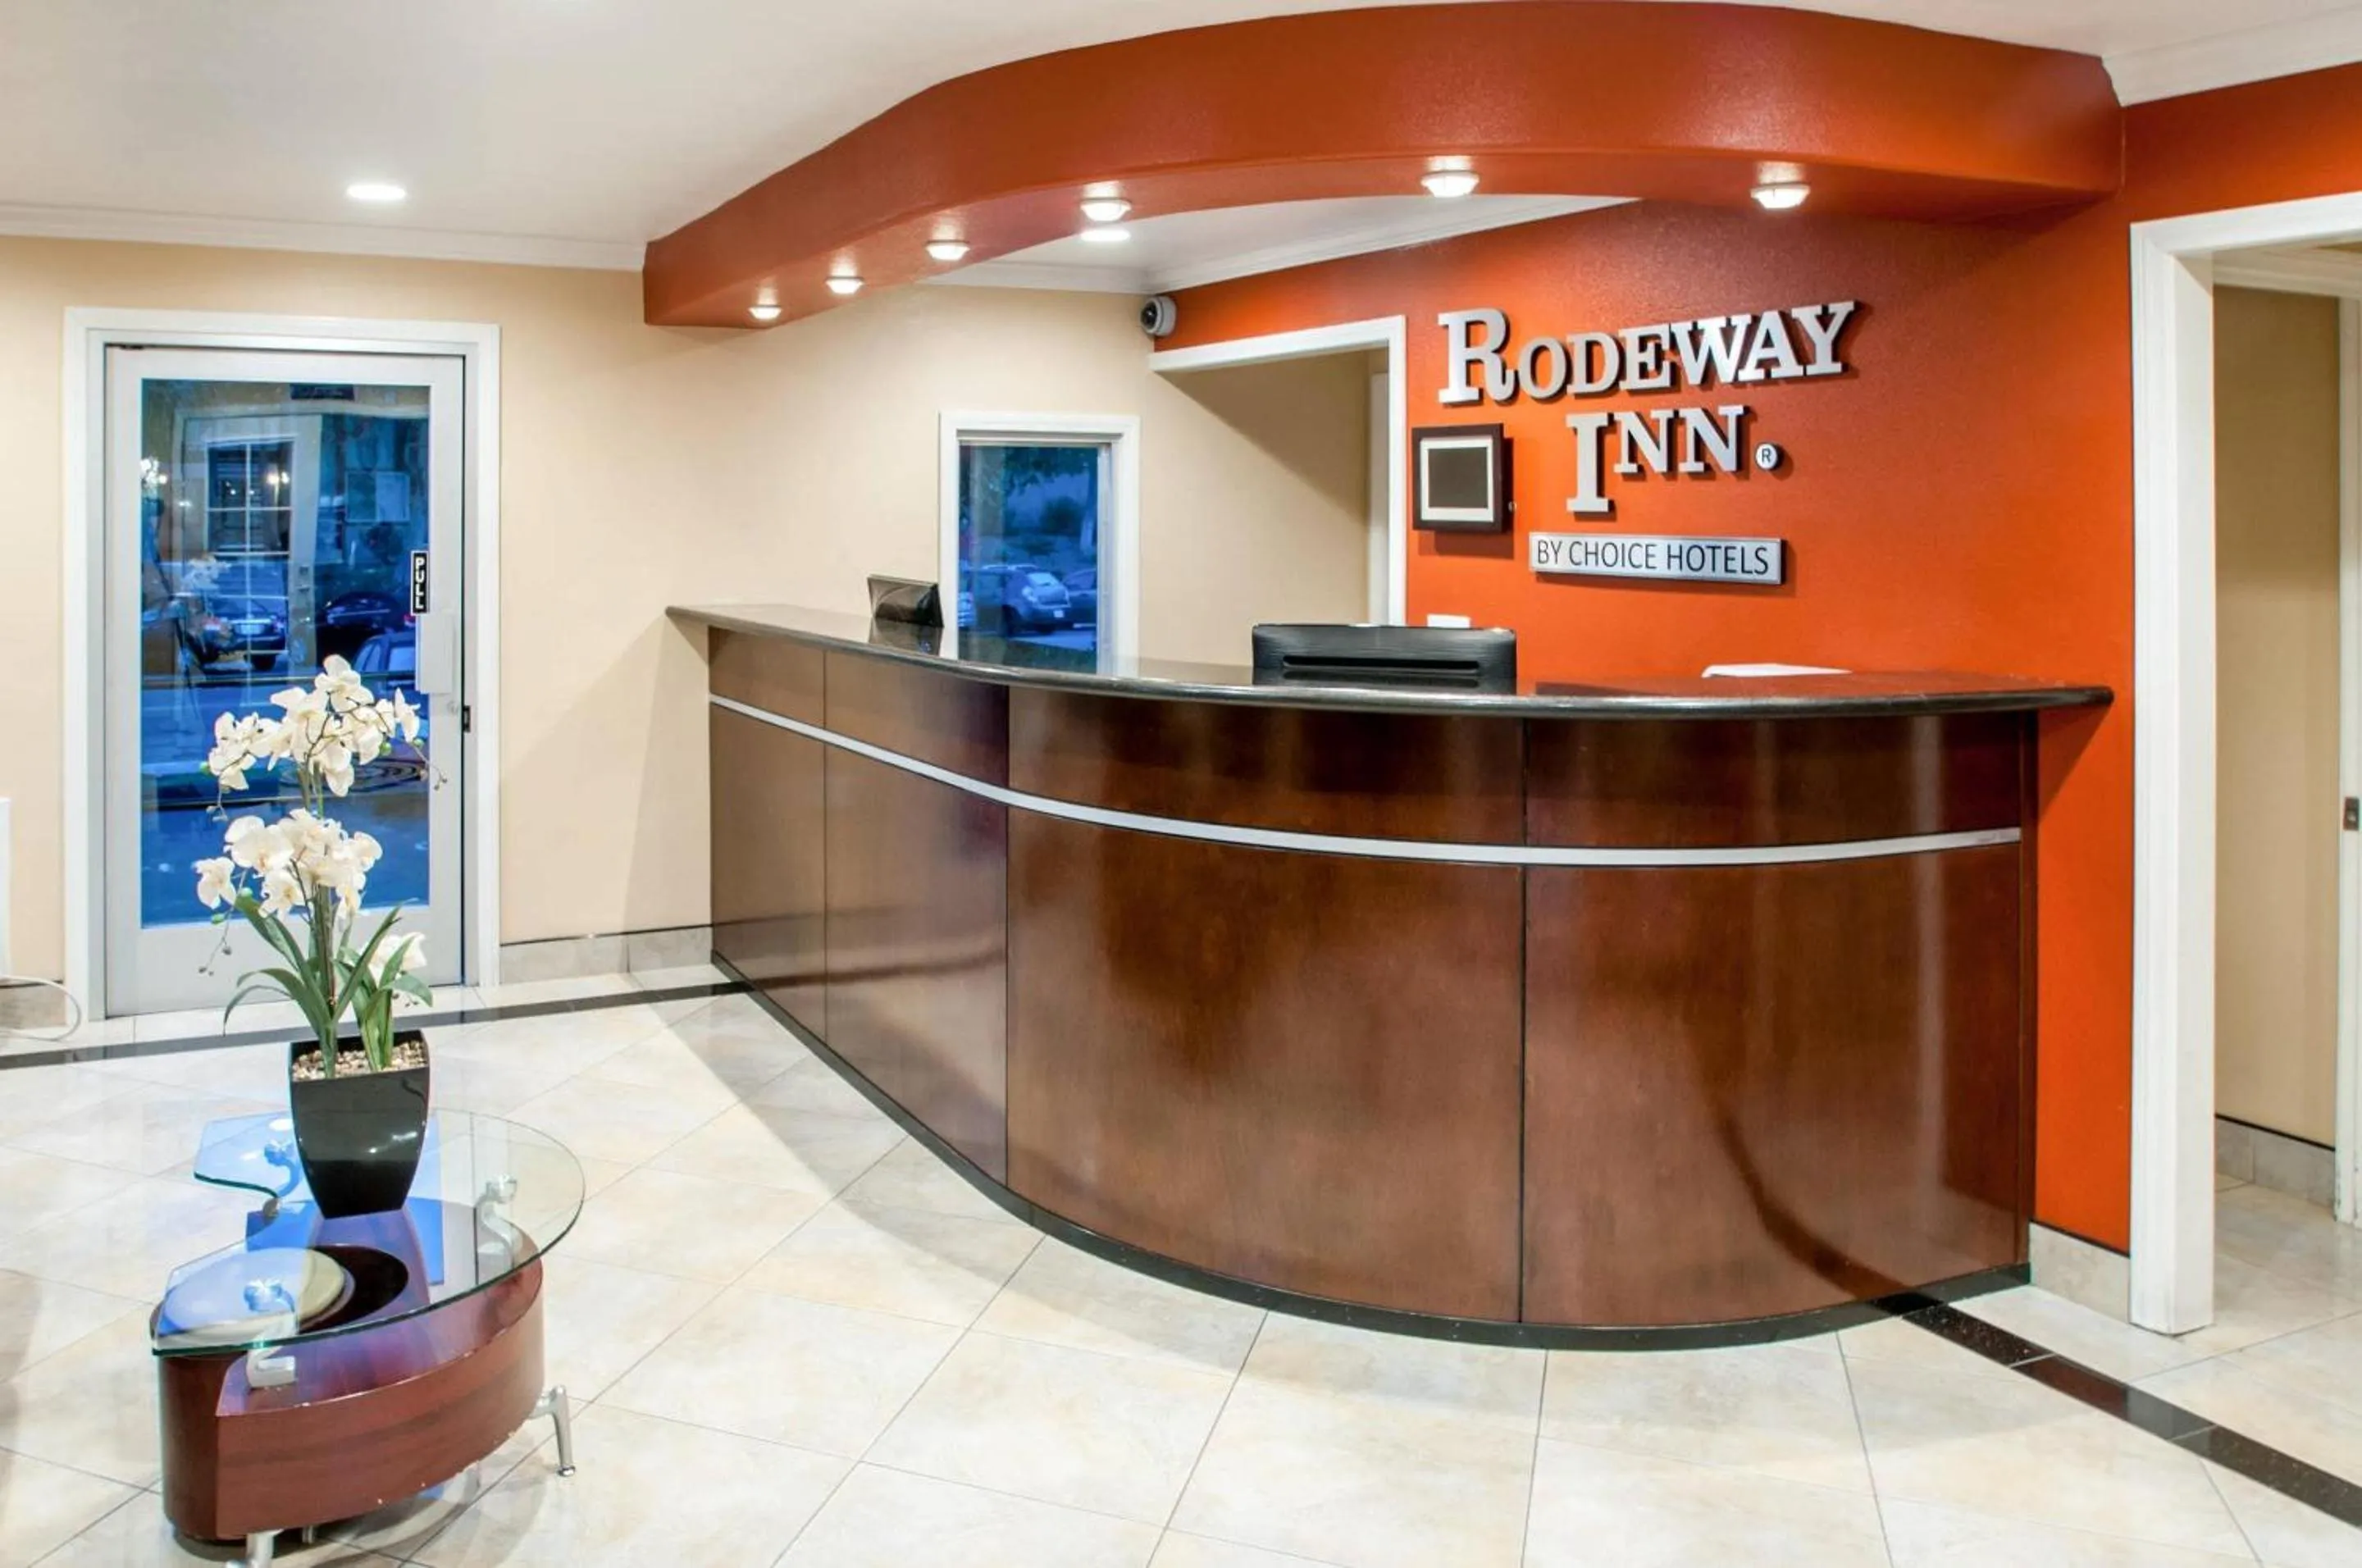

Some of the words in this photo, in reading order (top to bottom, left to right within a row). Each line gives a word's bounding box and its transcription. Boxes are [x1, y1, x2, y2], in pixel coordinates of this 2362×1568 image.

[1438, 301, 1855, 403] RODEWAY
[1566, 405, 1744, 513] INN
[414, 557, 425, 609] PULL
[1537, 539, 1562, 565] BY
[1568, 540, 1658, 569] CHOICE
[1667, 544, 1769, 576] HOTELS
